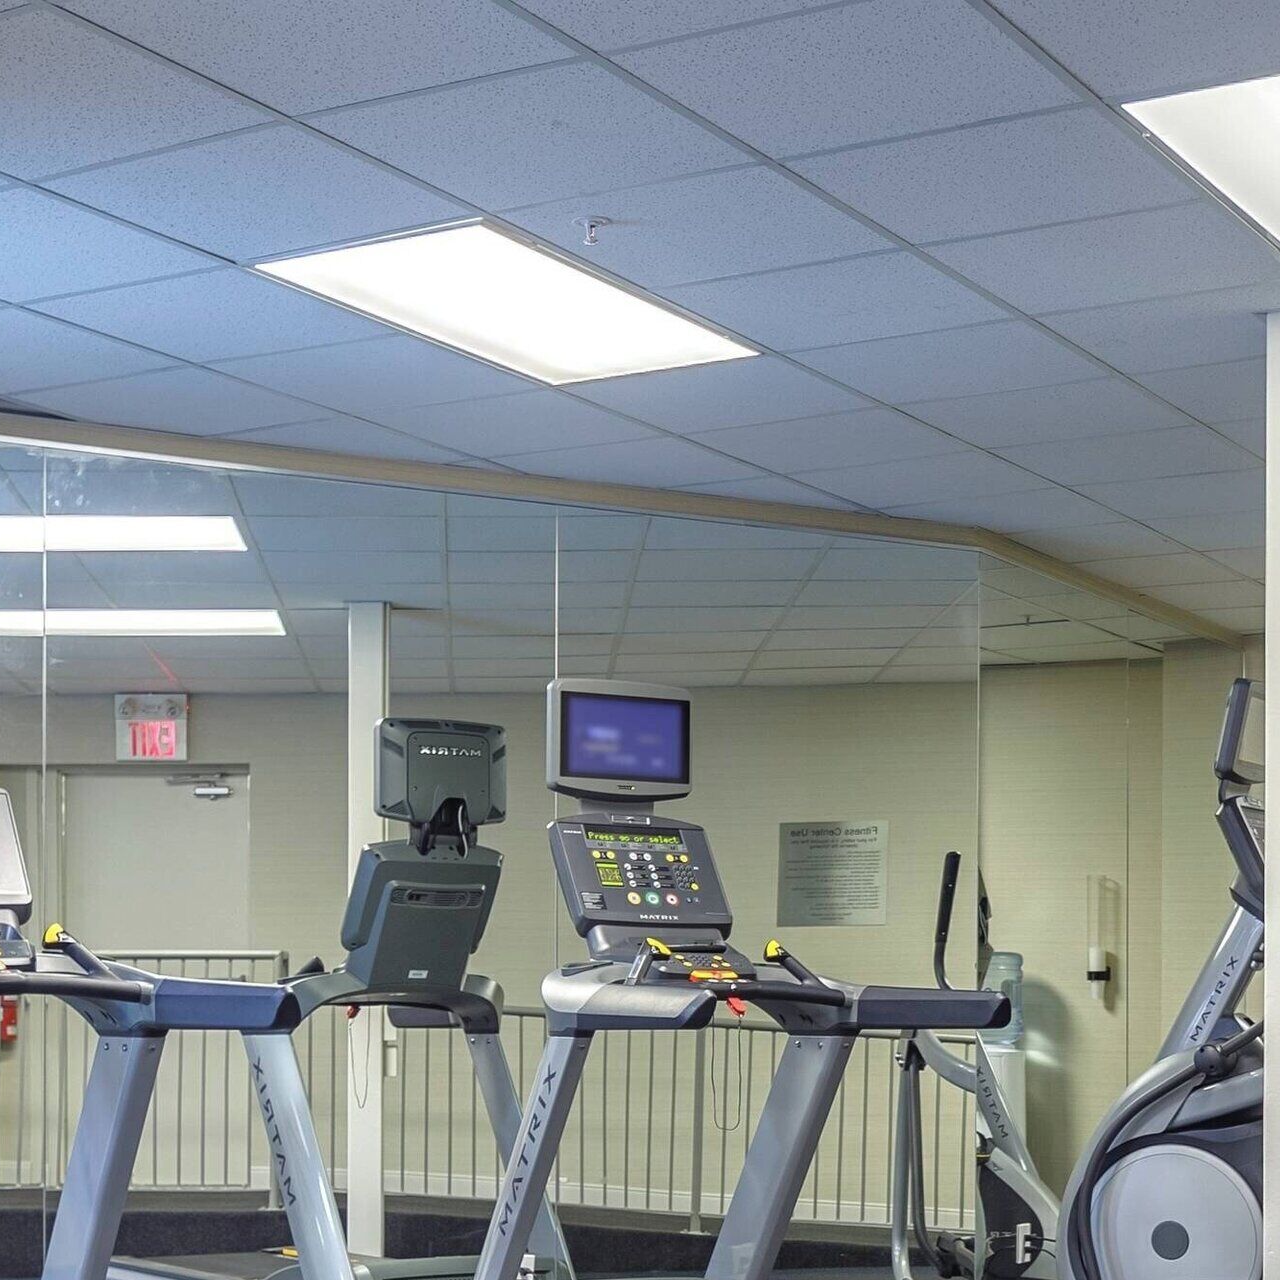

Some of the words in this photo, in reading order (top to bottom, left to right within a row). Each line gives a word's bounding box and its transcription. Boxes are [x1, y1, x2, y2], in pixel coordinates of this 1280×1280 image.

[587, 831, 615, 842] Press
[649, 835, 680, 844] select
[1190, 956, 1239, 1042] MATRIX
[499, 1062, 557, 1237] MATRIX
